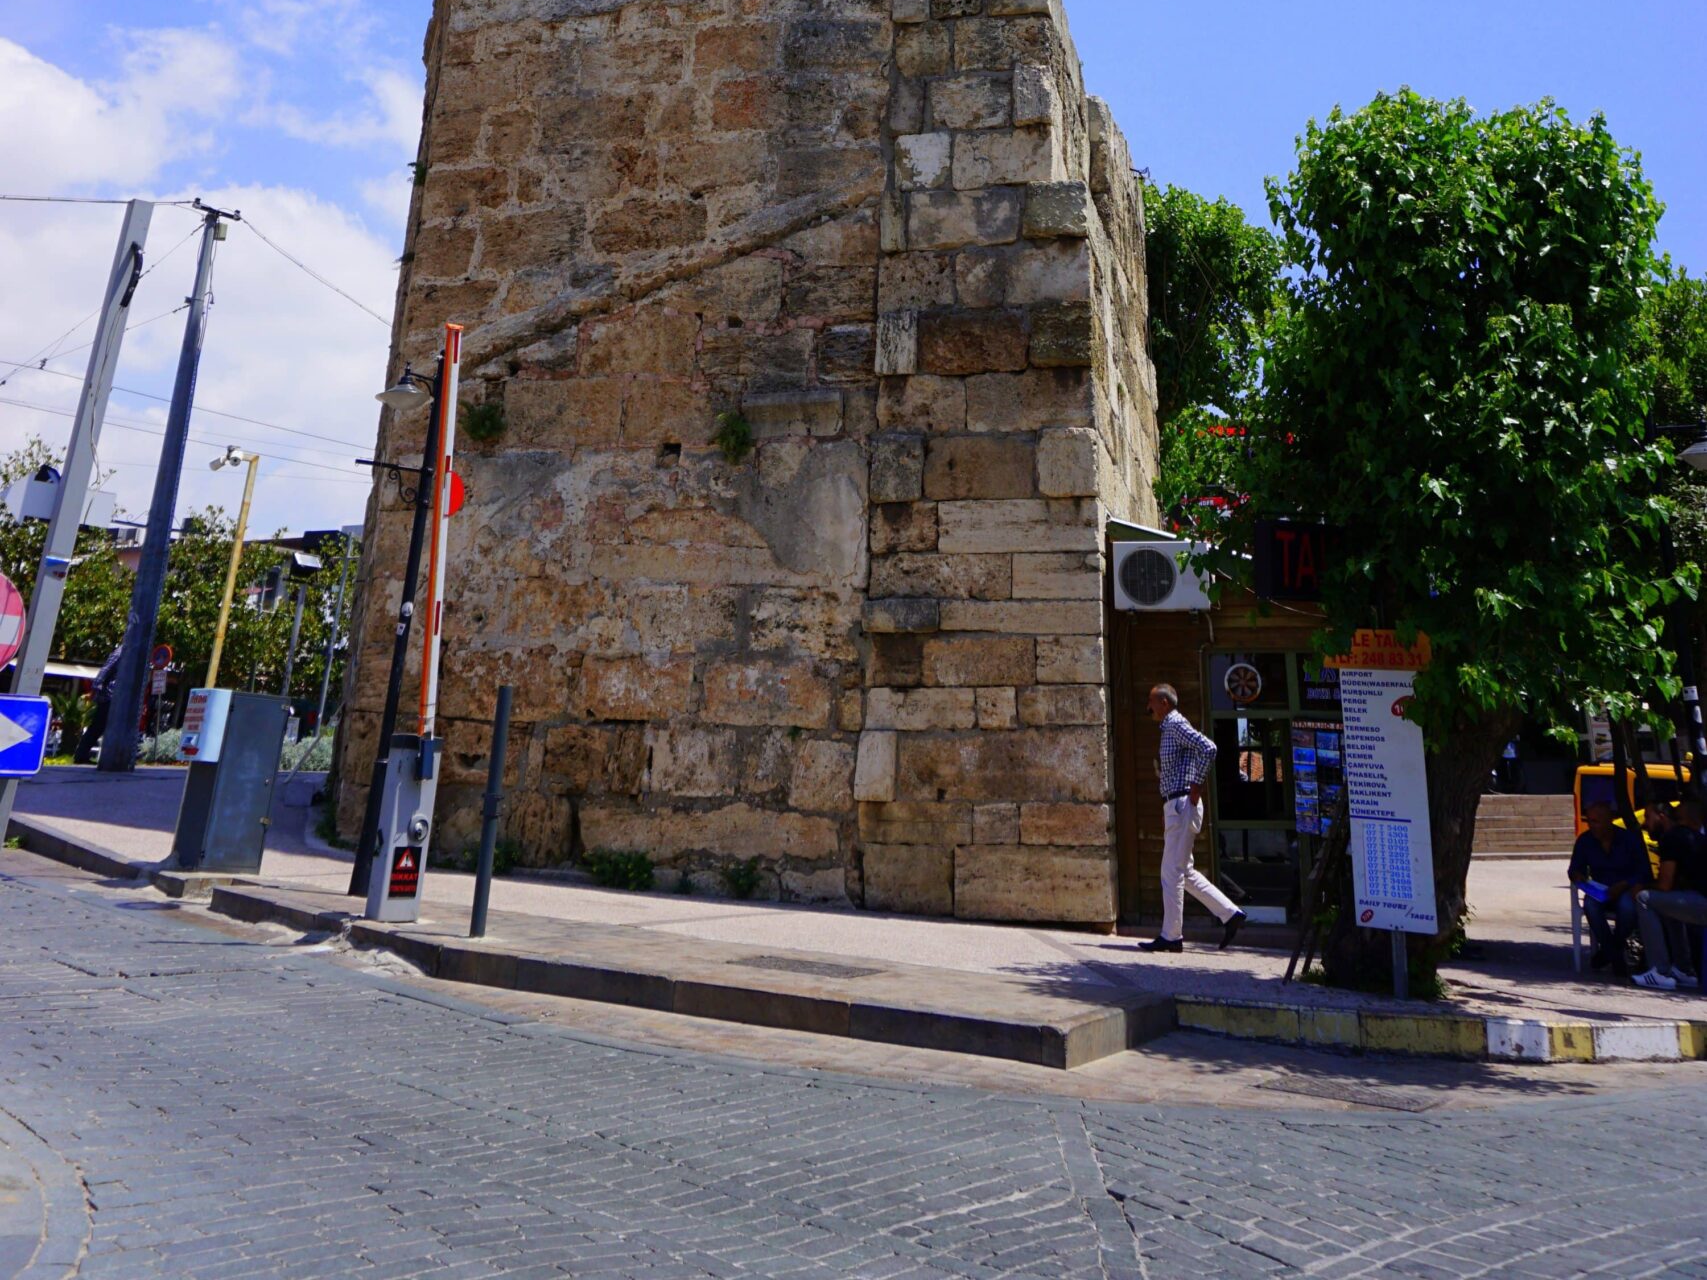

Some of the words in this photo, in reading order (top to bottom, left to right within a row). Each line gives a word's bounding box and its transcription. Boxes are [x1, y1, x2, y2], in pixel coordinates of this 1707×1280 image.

[1408, 653, 1424, 666] 31
[1351, 808, 1396, 816] TÜNEKTEPE
[1359, 899, 1380, 907] DAILY
[1383, 902, 1408, 910] TOURS
